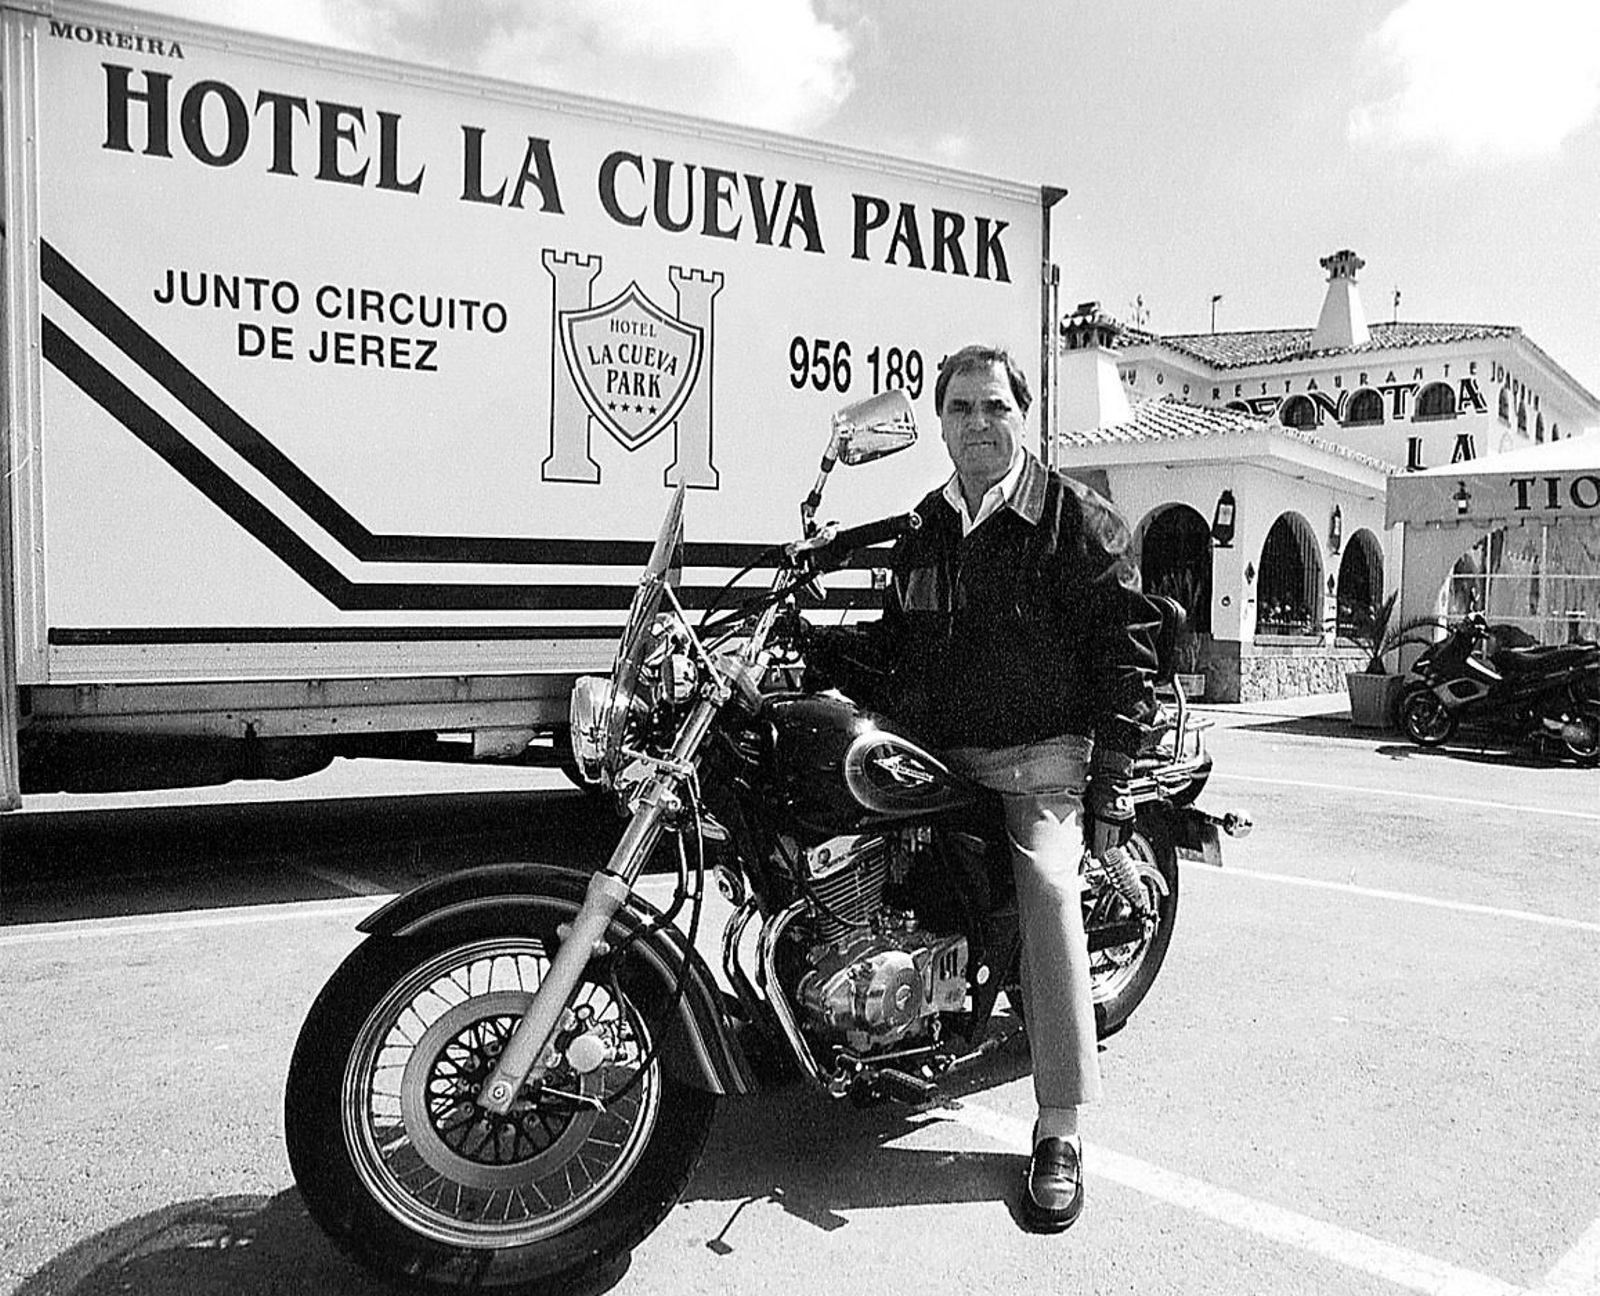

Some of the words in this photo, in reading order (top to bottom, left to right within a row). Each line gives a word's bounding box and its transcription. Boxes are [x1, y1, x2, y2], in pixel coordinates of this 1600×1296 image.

[49, 20, 184, 59] MOREIRA
[102, 63, 426, 194] HOTEL
[460, 125, 565, 214] LA
[598, 151, 825, 253] CUEVA
[851, 193, 1011, 283] PARK
[154, 270, 300, 314] JUNTO
[315, 286, 507, 333] CIRCUITO
[610, 318, 657, 337] HOTEL
[238, 324, 294, 360] DE
[309, 331, 438, 371] JEREZ
[587, 344, 614, 365] LA
[618, 344, 677, 376] CUEVA
[607, 369, 661, 399] PARK
[789, 336, 851, 393] 956
[867, 346, 923, 400] 189
[1407, 434, 1476, 473] LA
[1509, 475, 1600, 511] TIO
